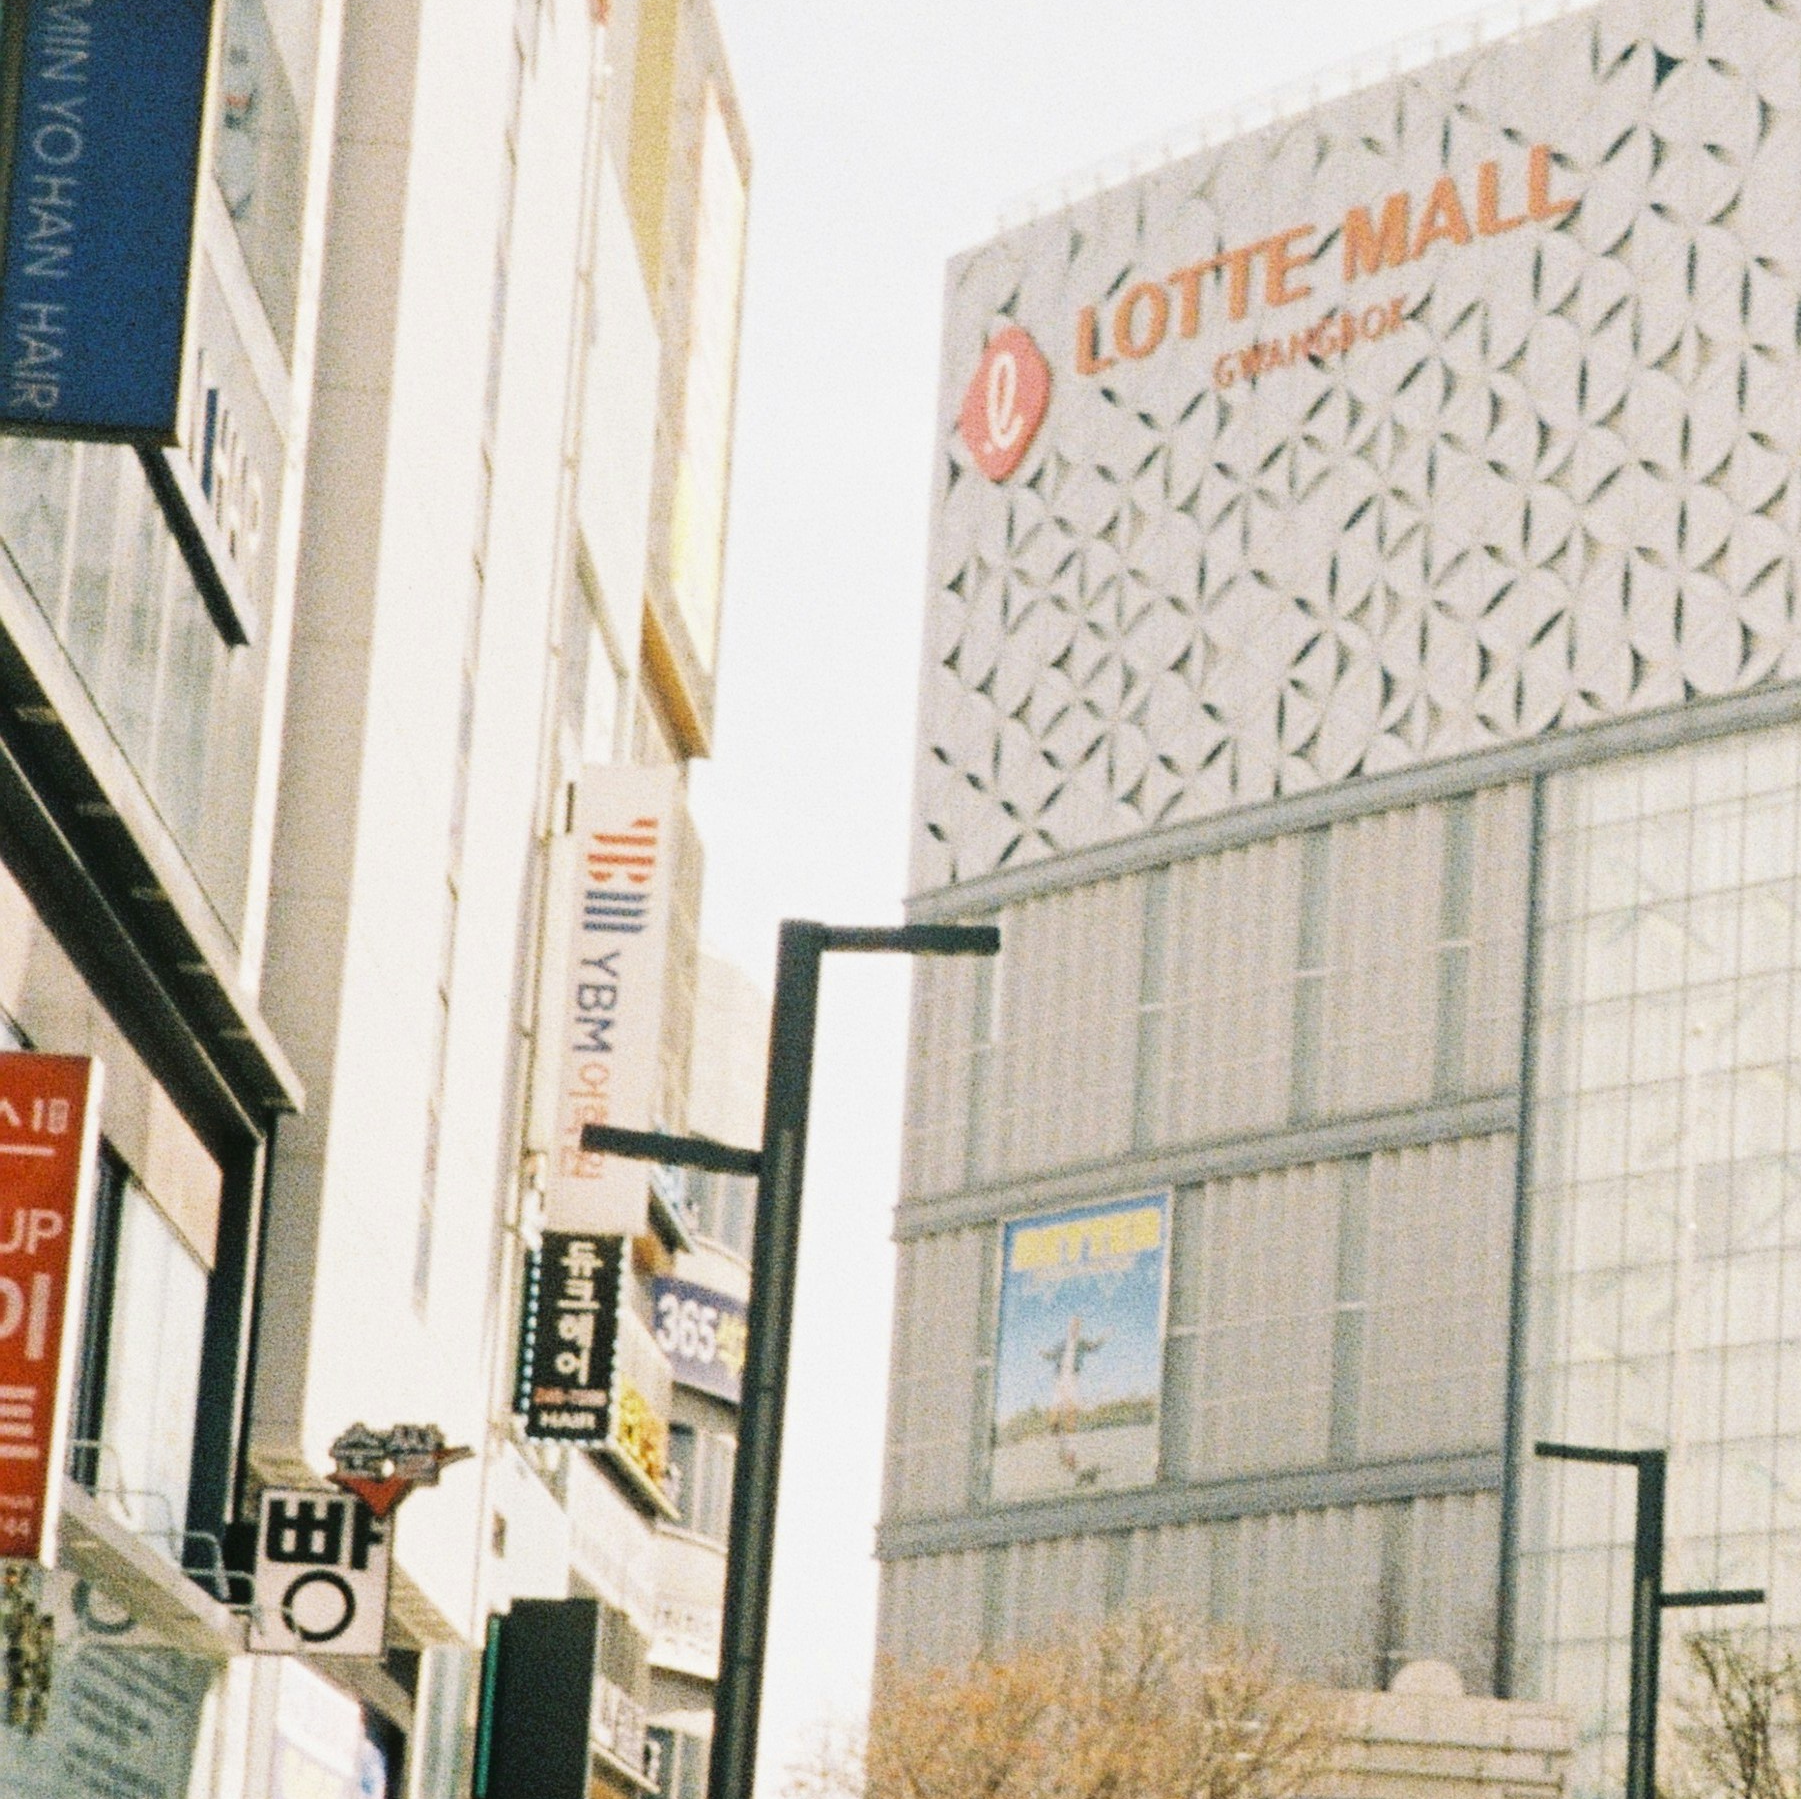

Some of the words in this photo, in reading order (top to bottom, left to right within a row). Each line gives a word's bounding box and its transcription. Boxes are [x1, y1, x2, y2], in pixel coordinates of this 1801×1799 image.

[1074, 225, 1316, 376] LOTTE
[1342, 143, 1578, 283] MALL
[10, 301, 66, 409] HAIR
[574, 951, 621, 1054] YBM
[265, 1499, 385, 1643] 빵
